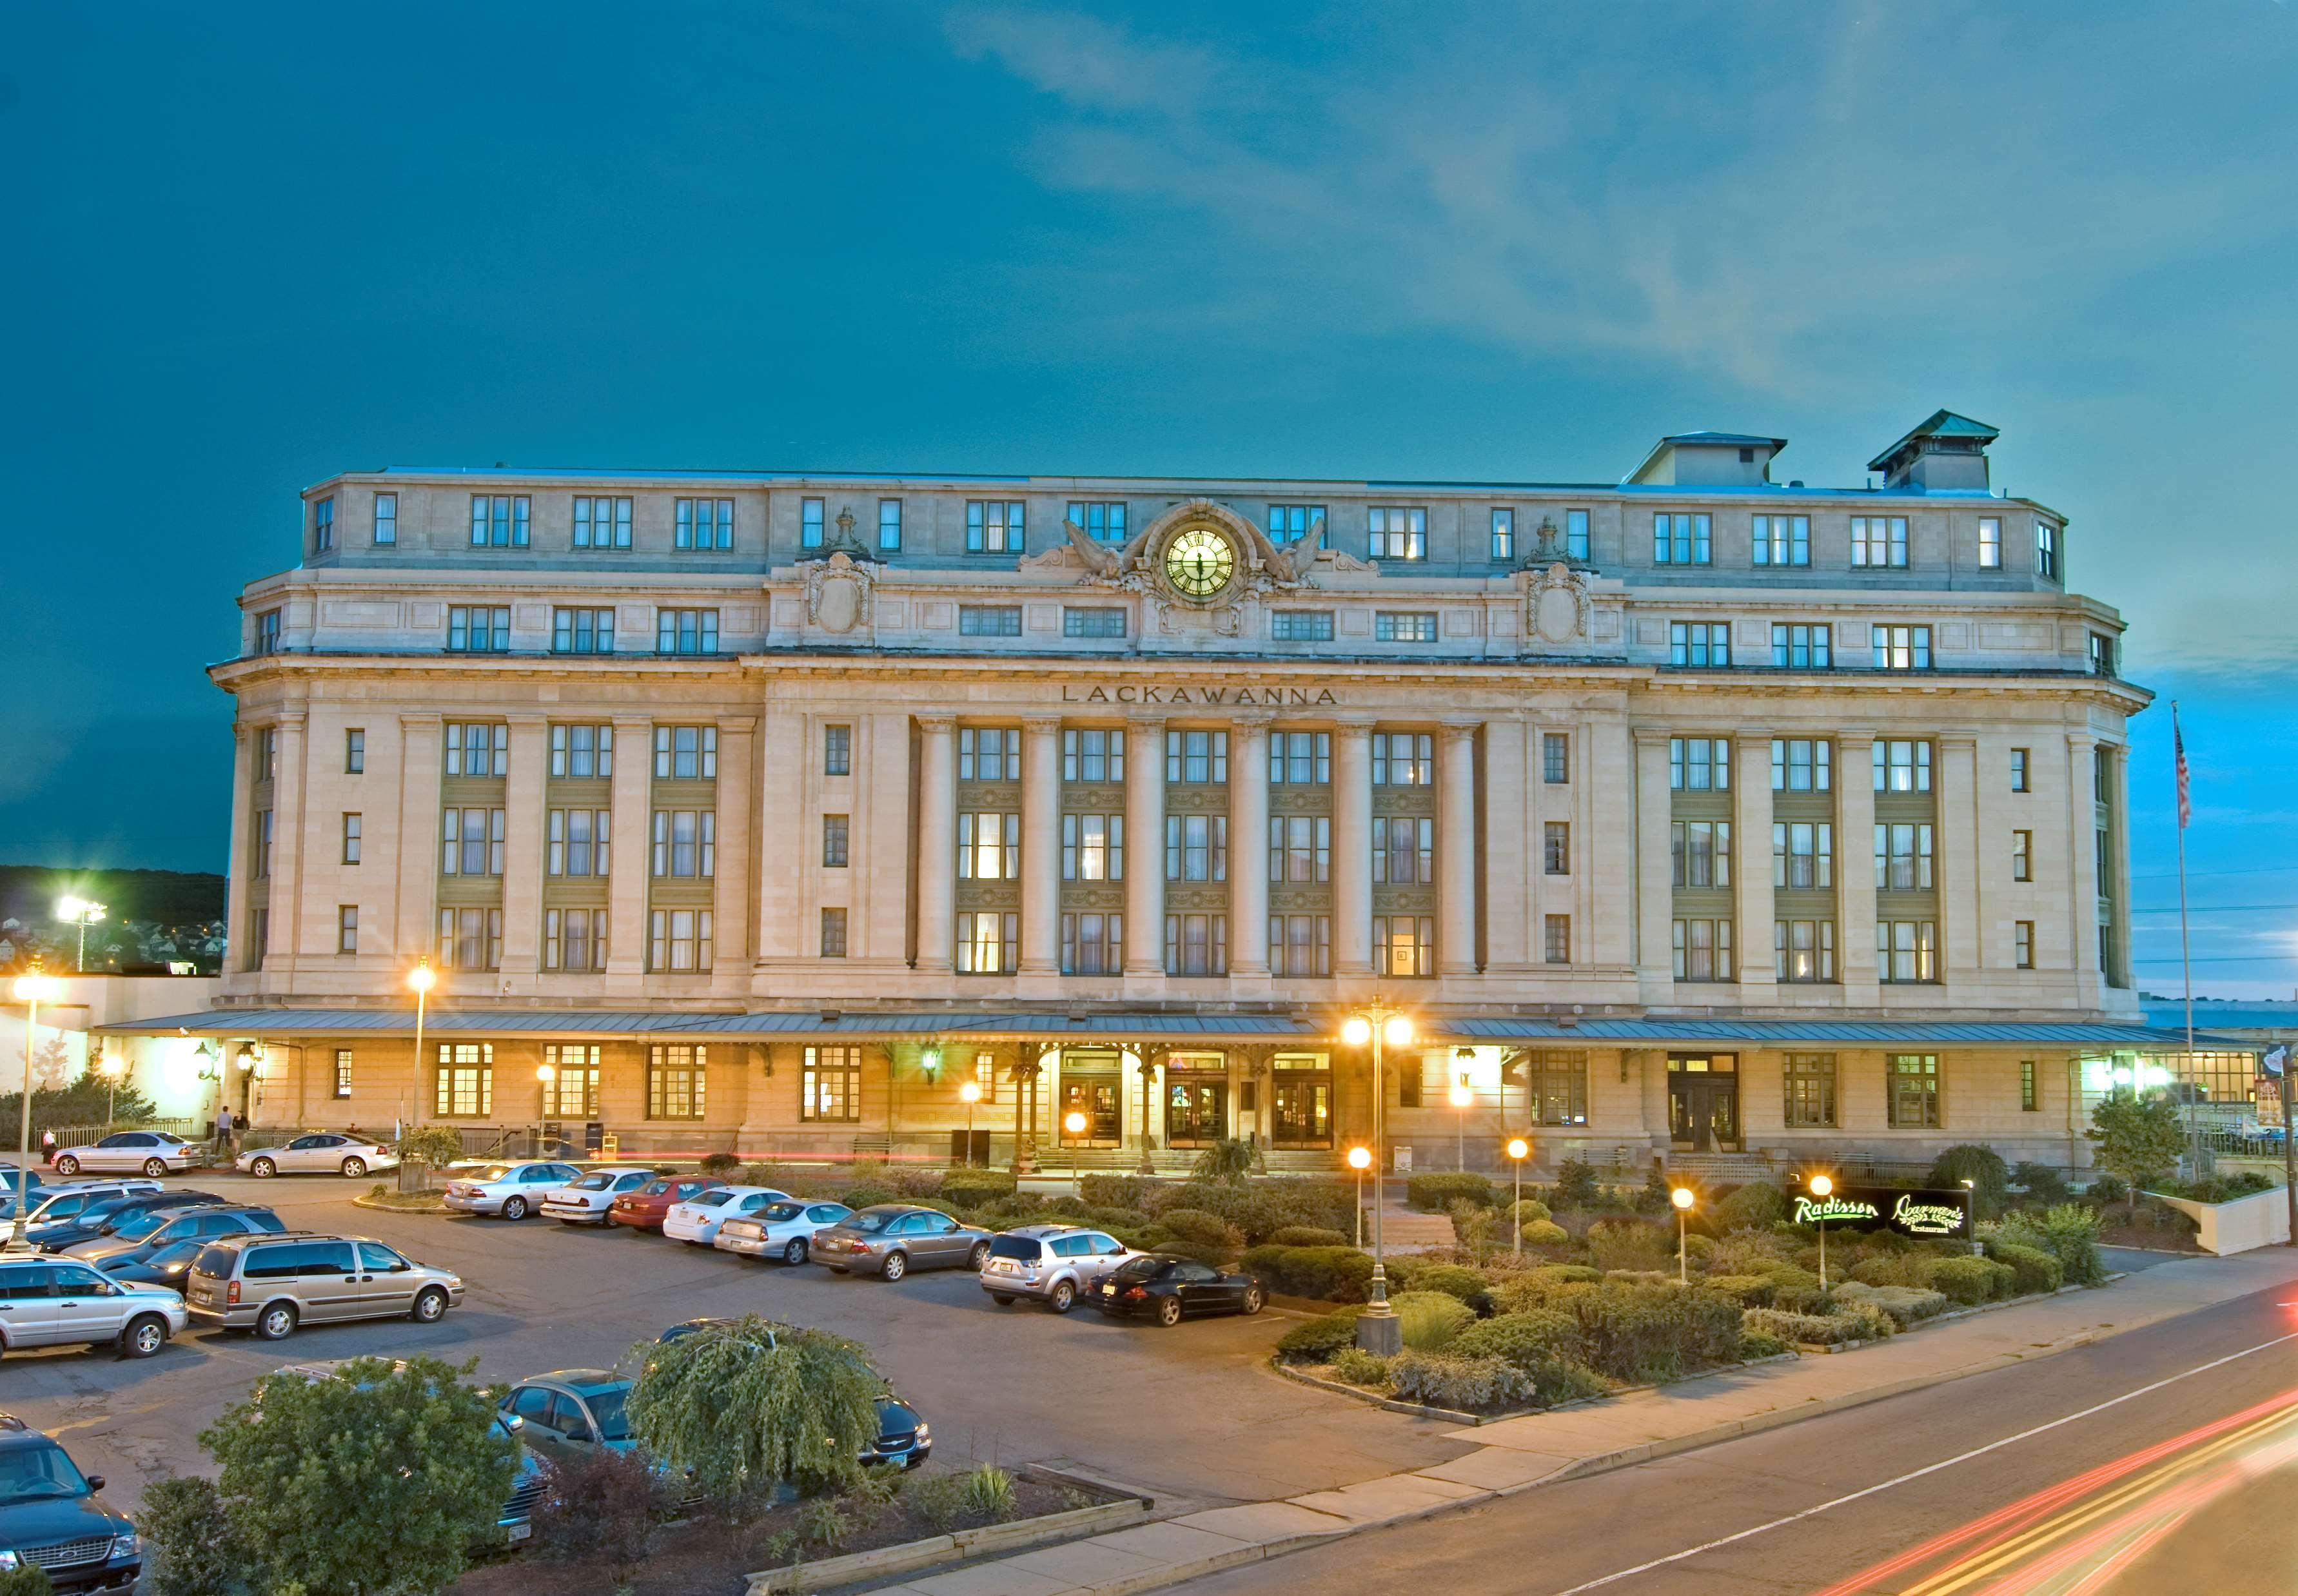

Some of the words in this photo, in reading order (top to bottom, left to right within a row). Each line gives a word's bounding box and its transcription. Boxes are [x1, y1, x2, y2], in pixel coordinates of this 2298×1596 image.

[1063, 685, 1337, 705] LACKAWANNA
[1794, 1195, 1878, 1223] Radisson
[1890, 1194, 1963, 1219] Carmen's
[1910, 1225, 1949, 1234] Restaurant
